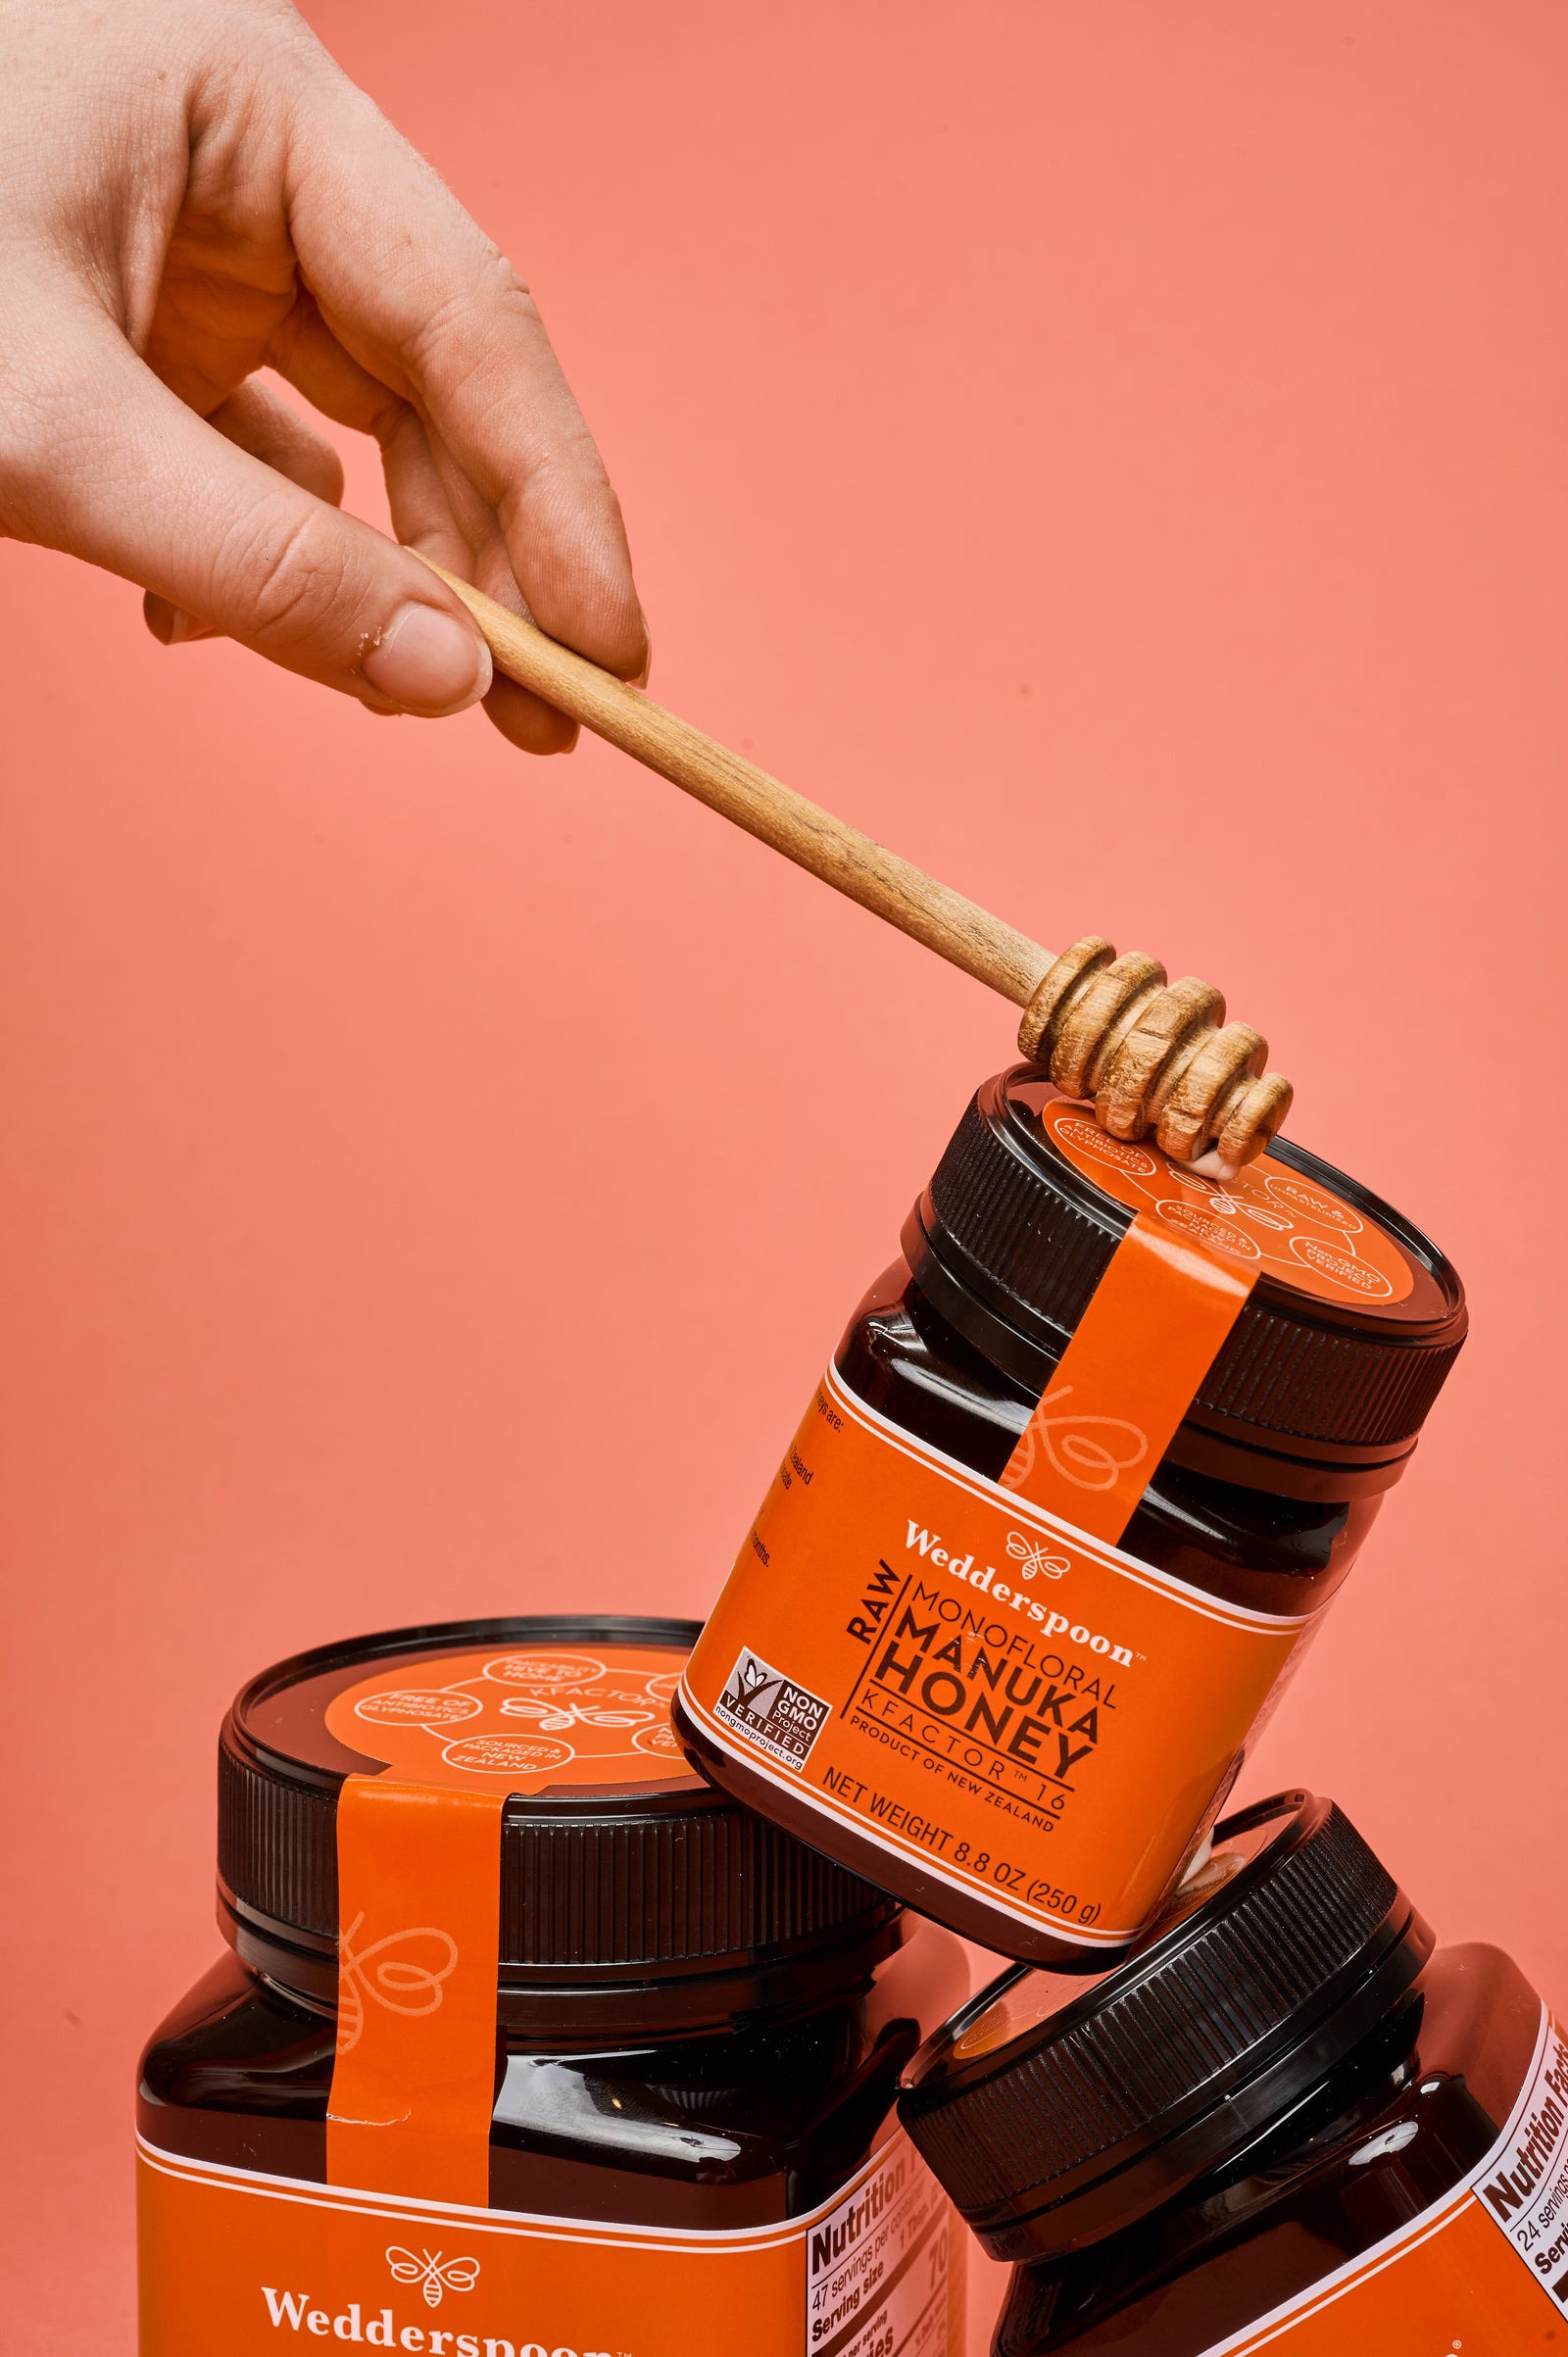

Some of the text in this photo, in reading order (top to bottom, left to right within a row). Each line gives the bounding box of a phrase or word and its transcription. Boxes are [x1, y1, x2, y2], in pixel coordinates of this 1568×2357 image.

[1059, 1127, 1146, 1173] GLYPHOSATE
[1063, 1124, 1148, 1168] ANTIBIOTICS
[1074, 1122, 1145, 1159] FREE OF
[1270, 1184, 1356, 1229] UNPASTEURIZED
[1286, 1186, 1328, 1208] RAW
[1168, 1206, 1235, 1243] PACKAGED
[1176, 1205, 1236, 1238] SOURCED
[1190, 1222, 1225, 1242] NEW
[1305, 1242, 1380, 1282] Non-GMO
[1306, 1253, 1371, 1289] VERIFIED
[1307, 1249, 1375, 1284] PROJECT
[826, 1409, 844, 1433] are:
[846, 1558, 902, 1645] RAW
[911, 1581, 1116, 1709] MONOFLORAL
[503, 1671, 565, 1683] HOME
[895, 1604, 1098, 1744] MANUKA
[360, 1704, 463, 1720] GLYPHOSATE
[370, 1698, 469, 1715] ANTIBIOTICS
[389, 1694, 440, 1704] FREE
[777, 1700, 816, 1731] GMO
[783, 1686, 823, 1719] NON
[874, 1641, 1095, 1779] HONEY
[715, 1705, 804, 1771] nongmoproject.org
[725, 1695, 805, 1755] VERIFIED
[772, 1710, 811, 1742] Project
[452, 1754, 538, 1770] ZEALAND
[463, 1743, 543, 1757] PACKAGED
[476, 1740, 549, 1752] SOURCED
[481, 1751, 526, 1761] NEW
[850, 1715, 1054, 1833] PRODUCT OF NEW ZEALAND
[1037, 1783, 1066, 1811] 16
[822, 1766, 1102, 1926] NET WEIGHT 8.8 OZ (250 g)
[1483, 2095, 1565, 2224] Nutrition
[811, 2157, 906, 2276] Nutrition
[1517, 2220, 1542, 2252] 24
[812, 2283, 828, 2312] 47
[831, 2243, 873, 2298] servings
[874, 2229, 889, 2253] per
[929, 2226, 948, 2290] 70
[811, 2288, 859, 2342] Serving
[862, 2259, 884, 2297] size
